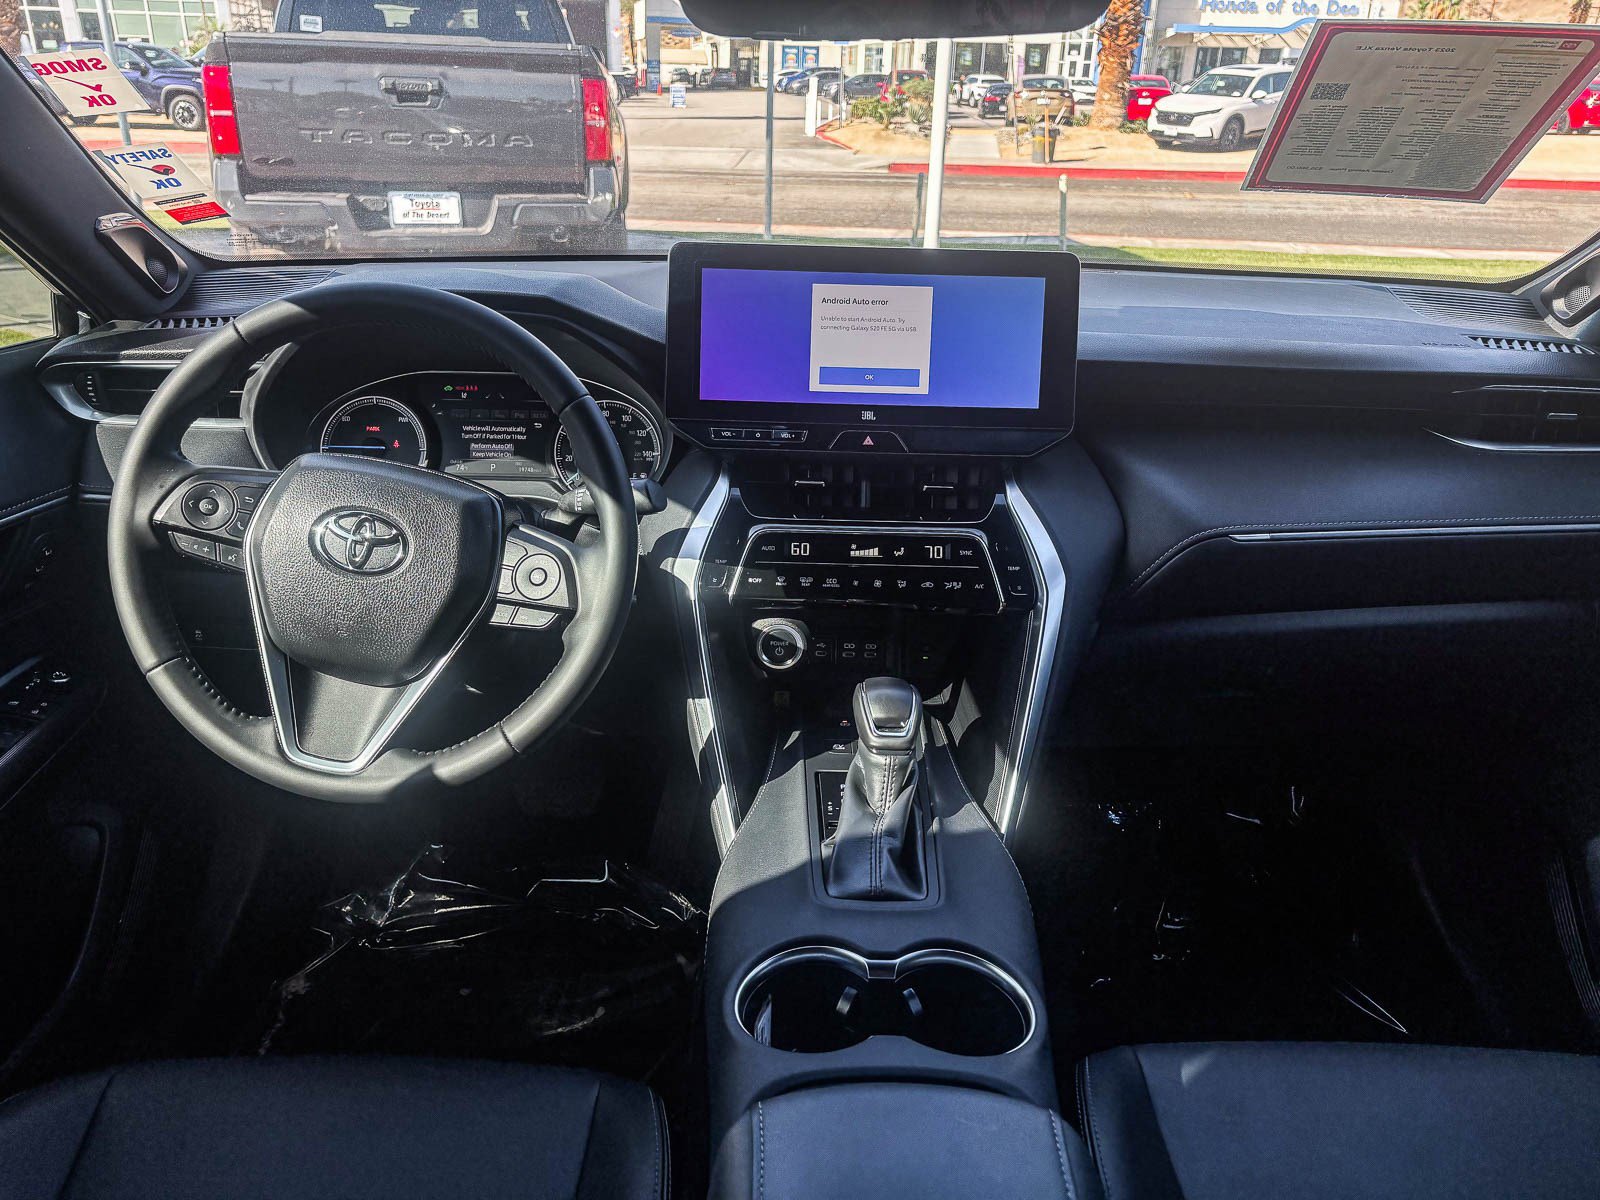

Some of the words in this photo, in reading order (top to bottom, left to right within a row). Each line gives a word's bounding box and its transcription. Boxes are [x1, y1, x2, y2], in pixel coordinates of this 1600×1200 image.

[1200, 0, 1258, 14] Honda
[1266, 0, 1284, 14] of
[1292, 0, 1319, 14] the
[299, 128, 534, 148] TACOMA
[410, 199, 440, 209] Toyota
[862, 410, 876, 421] JBL
[791, 543, 810, 556] 60
[924, 546, 943, 559] 70
